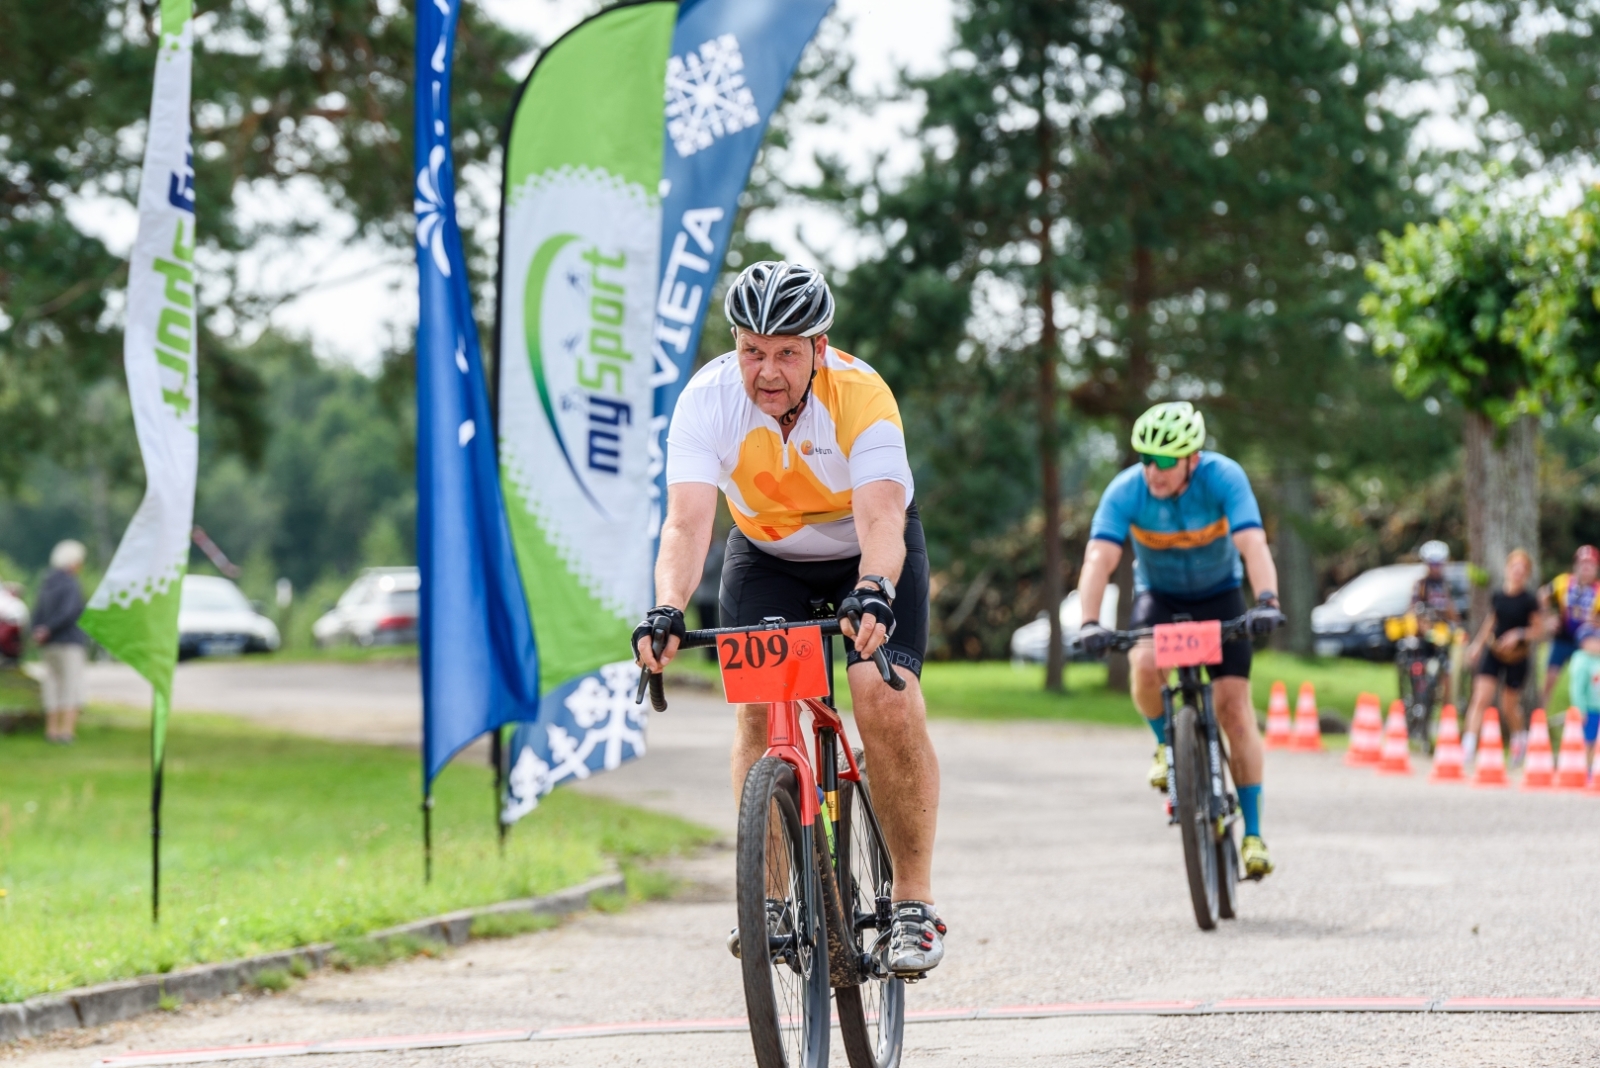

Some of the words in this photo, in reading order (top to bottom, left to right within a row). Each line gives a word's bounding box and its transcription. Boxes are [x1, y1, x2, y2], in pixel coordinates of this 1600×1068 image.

[648, 206, 724, 388] VIETA
[577, 246, 632, 474] mySport
[721, 634, 788, 670] 209
[1158, 633, 1199, 653] 226
